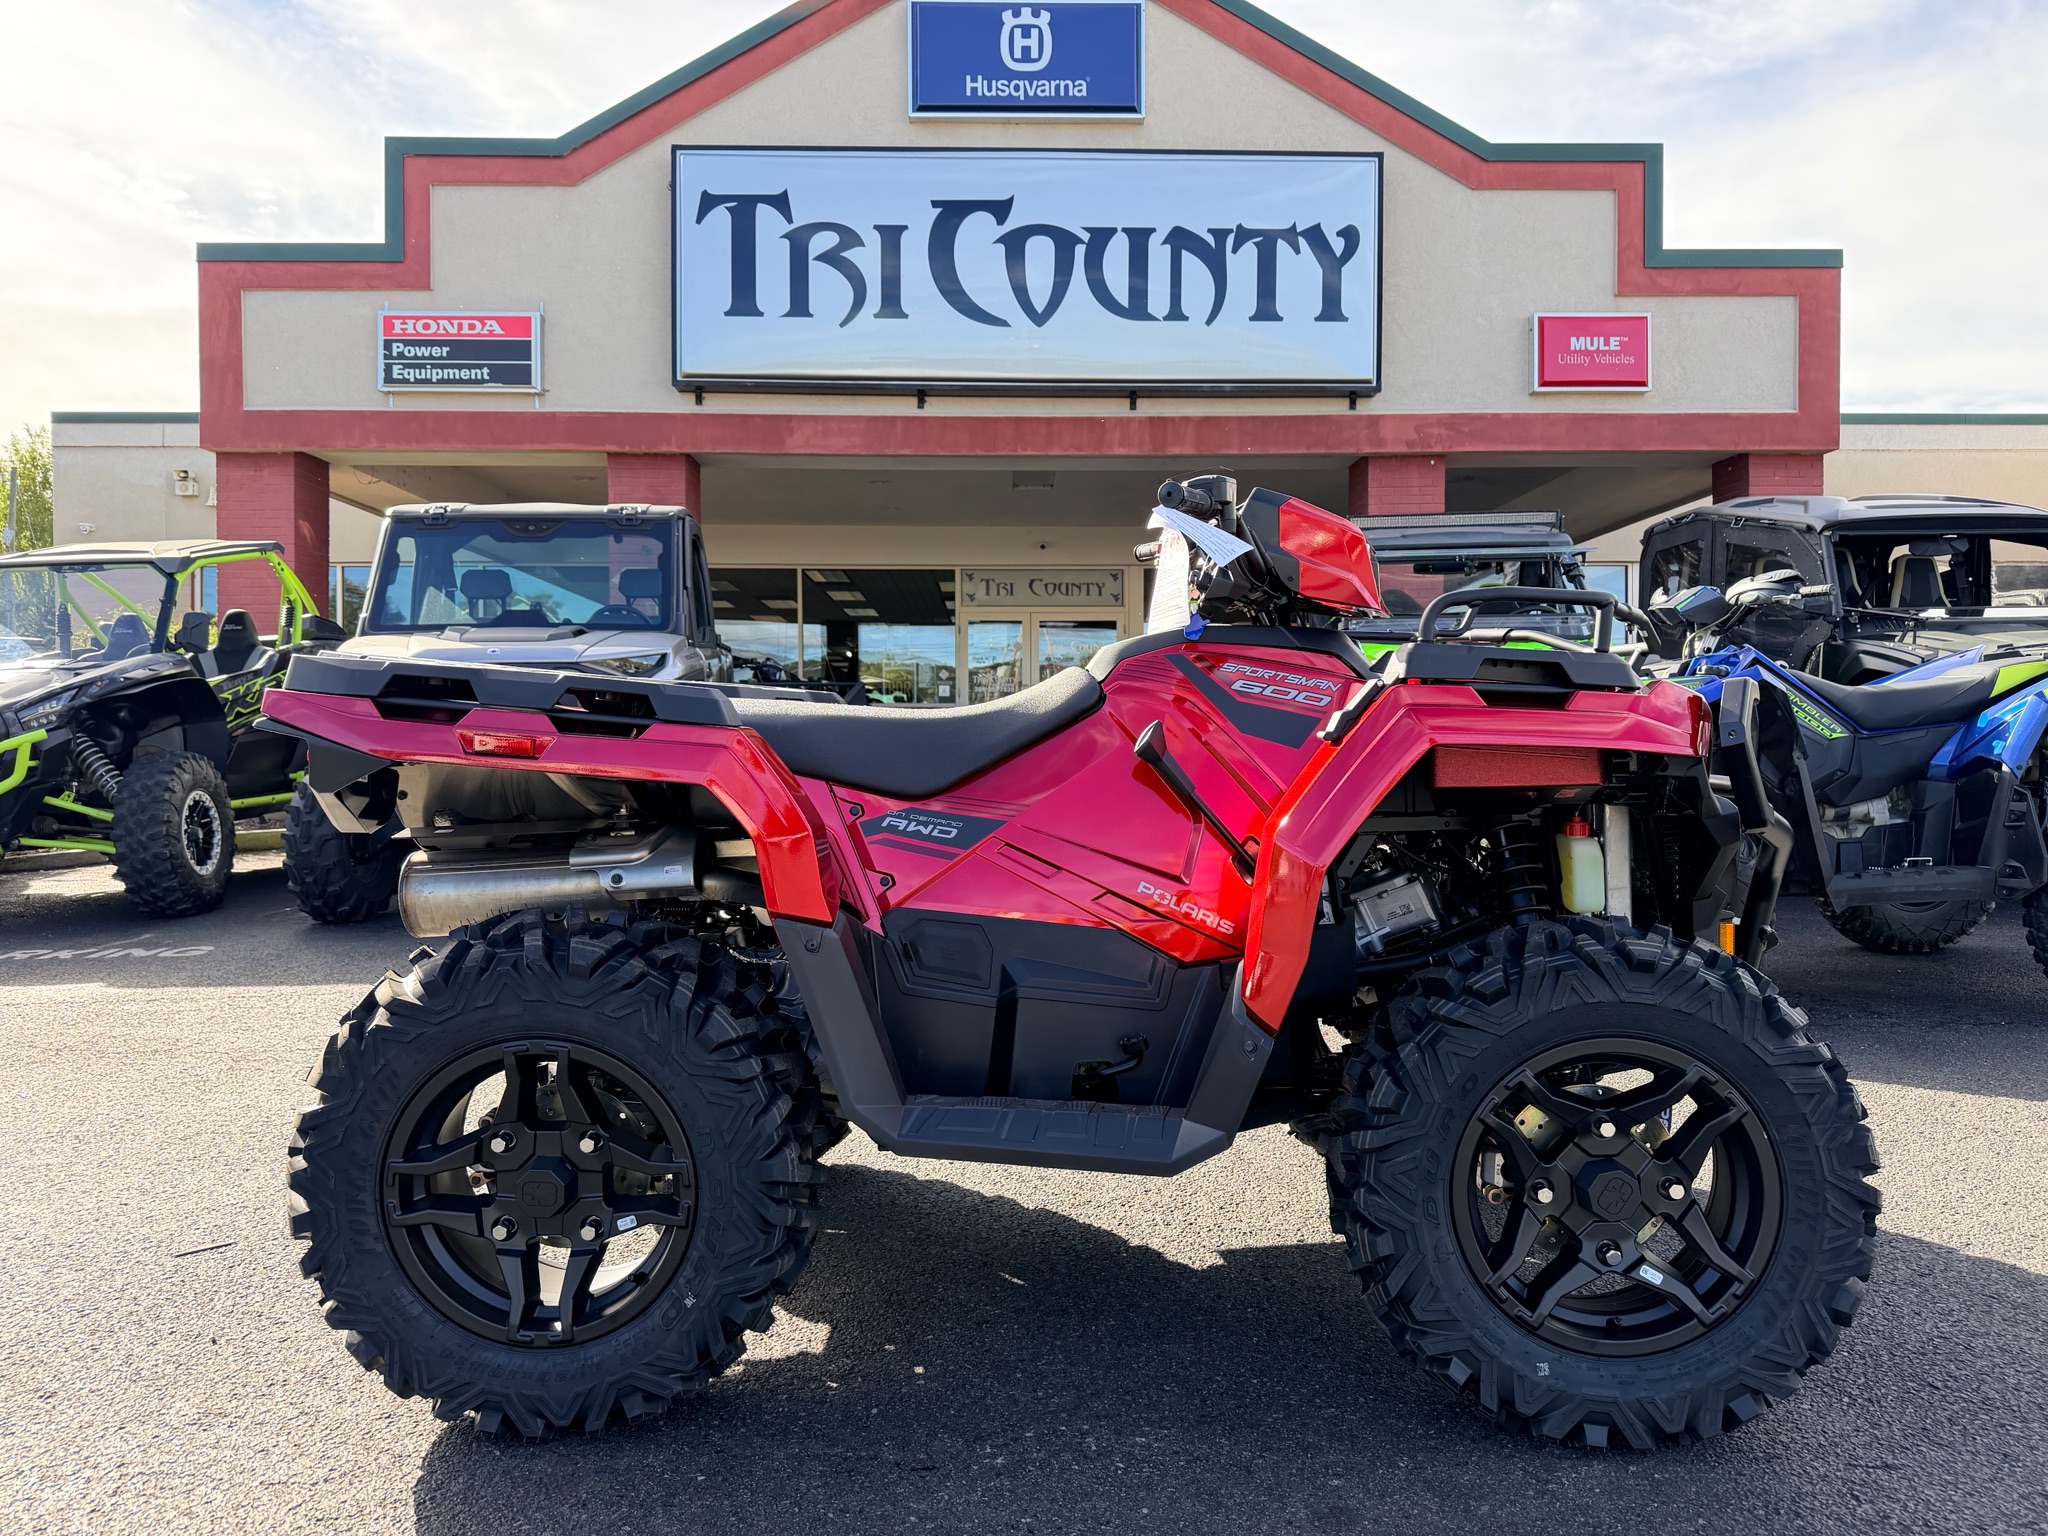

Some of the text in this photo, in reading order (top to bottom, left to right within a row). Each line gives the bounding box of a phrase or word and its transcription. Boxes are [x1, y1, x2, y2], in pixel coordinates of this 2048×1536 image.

[965, 74, 1087, 101] Husqvarna
[696, 189, 1360, 328] TRI COUNTY
[391, 319, 505, 335] HONDA
[391, 342, 450, 357] Power
[1557, 352, 1636, 367] Utility Vehicles
[391, 364, 491, 383] Equipment
[1028, 578, 1106, 597] COUNTY
[1218, 662, 1343, 692] SPORTSMAN
[1230, 679, 1333, 707] 600
[880, 816, 958, 839] AWD
[886, 809, 964, 828] ON DEMAND
[1136, 880, 1235, 935] POLARIS
